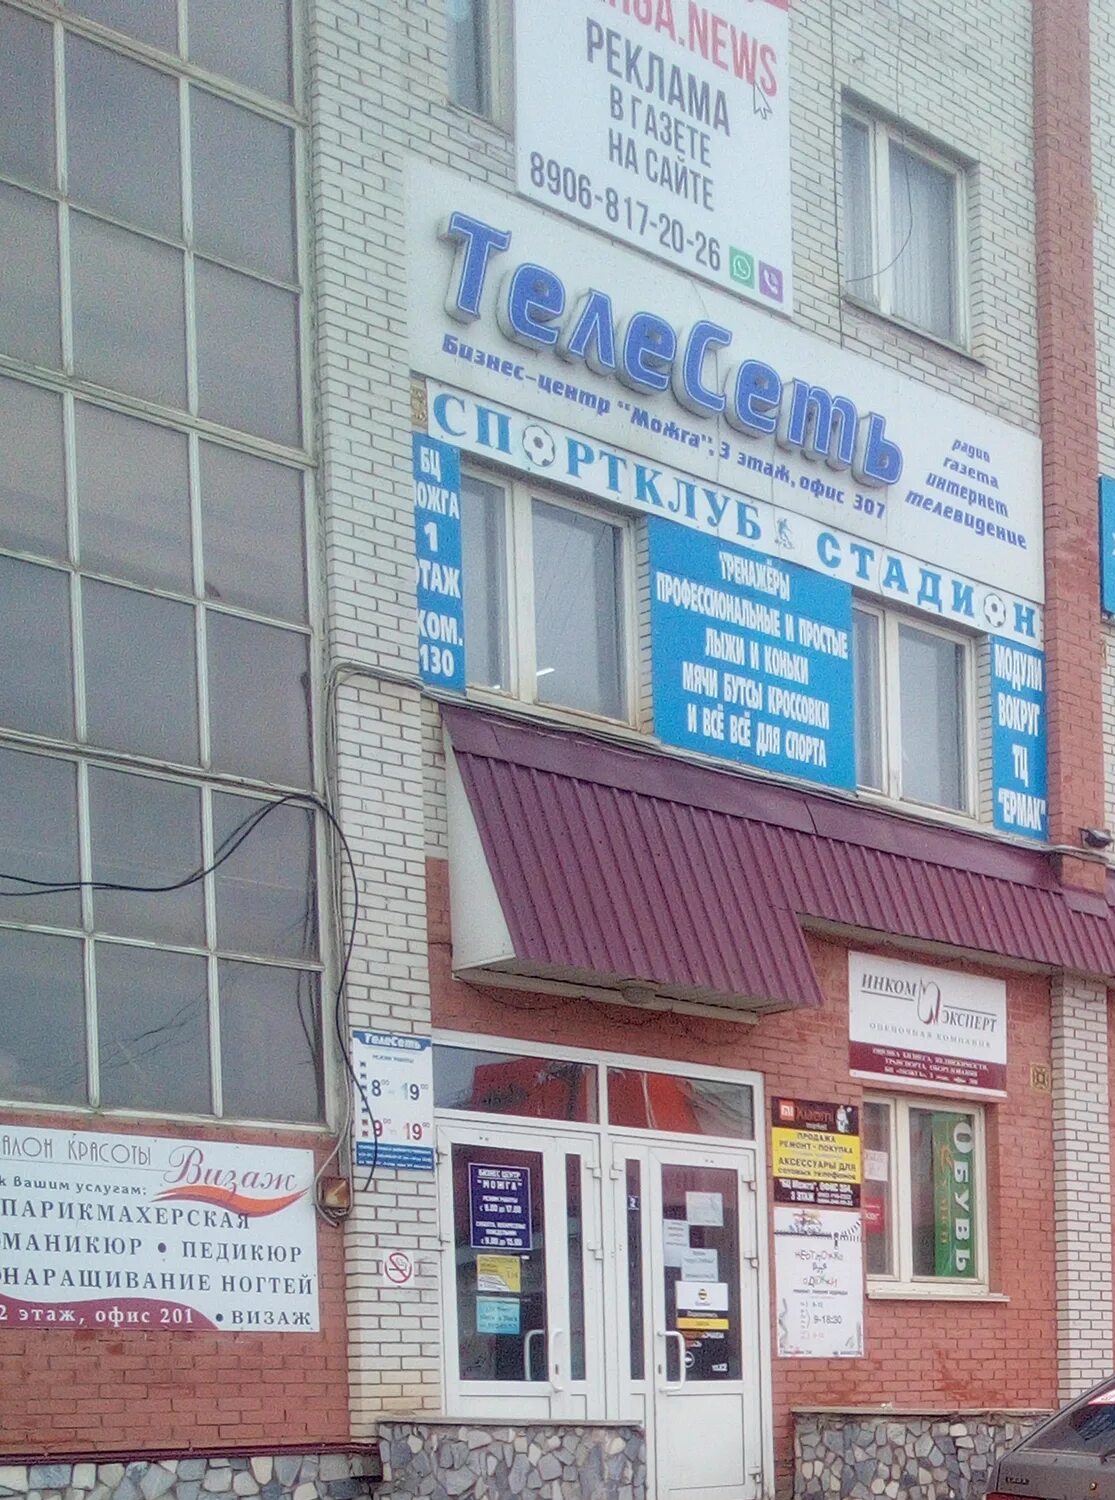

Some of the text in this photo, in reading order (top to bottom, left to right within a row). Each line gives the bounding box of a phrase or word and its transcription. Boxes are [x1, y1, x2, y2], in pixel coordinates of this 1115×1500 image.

[586, 17, 731, 137] РЕКЛАМА
[609, 83, 713, 168] В ГАЗЕТЕ
[607, 127, 715, 212] НА САЙТЕ
[529, 151, 721, 272] 8906-817-20-26
[448, 210, 905, 487] ТелеСеть
[441, 333, 886, 519] Бизнес-центр 3 этаж, офис 307
[419, 446, 442, 483] БЦ
[951, 438, 991, 463] радио
[943, 455, 1000, 489] газета
[414, 478, 460, 520] ОЖГА
[925, 472, 1010, 518] интернет
[423, 521, 438, 552] 1
[905, 489, 1028, 550] телевидение
[416, 557, 461, 599] ТАЖ
[719, 550, 791, 602] ТРЕНАЖЁРЫ
[656, 571, 849, 660] ПРОФЕССИОНАЛЬНЫЕ И ПРОСТЫЕ
[419, 644, 455, 678] 130
[705, 627, 809, 686] ЛЫЖИ И КОНЬКИ
[994, 643, 1043, 692] МОДУЛИ
[682, 661, 830, 731] МЯЧИ БУТСЫ КРОССОВКИ
[998, 692, 1040, 737] ВОКРУГ
[687, 702, 827, 768] И ВСЁ ВСЁ ДЛЯ СПОРТА
[1012, 743, 1029, 788] ТЦ
[998, 787, 1046, 832] "ЕРМАК"
[862, 973, 917, 998] ИНКОМ
[868, 1022, 992, 1049] ОЦЕНОЧНАЯ КОМПАНИЯ
[941, 1010, 998, 1033] ЭКСПЕРТ
[371, 1079, 382, 1097] 8
[403, 1122, 423, 1141] 19
[778, 1139, 811, 1151] РЕМОНТ
[818, 1144, 854, 1155] ПОКУПКА
[796, 1132, 836, 1143] ПРОДАЖА
[13, 1175, 70, 1191] Вашим
[68, 1139, 298, 1195] КРАСОТЫ Визаж
[477, 1179, 523, 1191] "МОЖГА"
[778, 1157, 837, 1171] АКСЕССУАРЫ
[838, 1162, 857, 1173] ДЛЯ
[1, 1198, 251, 1230] ПАРИКМАХЕРСКАЯ
[953, 1121, 975, 1272] ОБУВЬ
[2, 1232, 303, 1263] МАНИКЮР ПЕДИКЮР
[2, 1267, 313, 1296] НАРАЩИВАНИЕ НОГТЕЙ
[18, 1307, 85, 1325] этаж,
[95, 1308, 151, 1328] офис
[160, 1307, 194, 1324] 201
[231, 1309, 311, 1326] ВИЗАЖ
